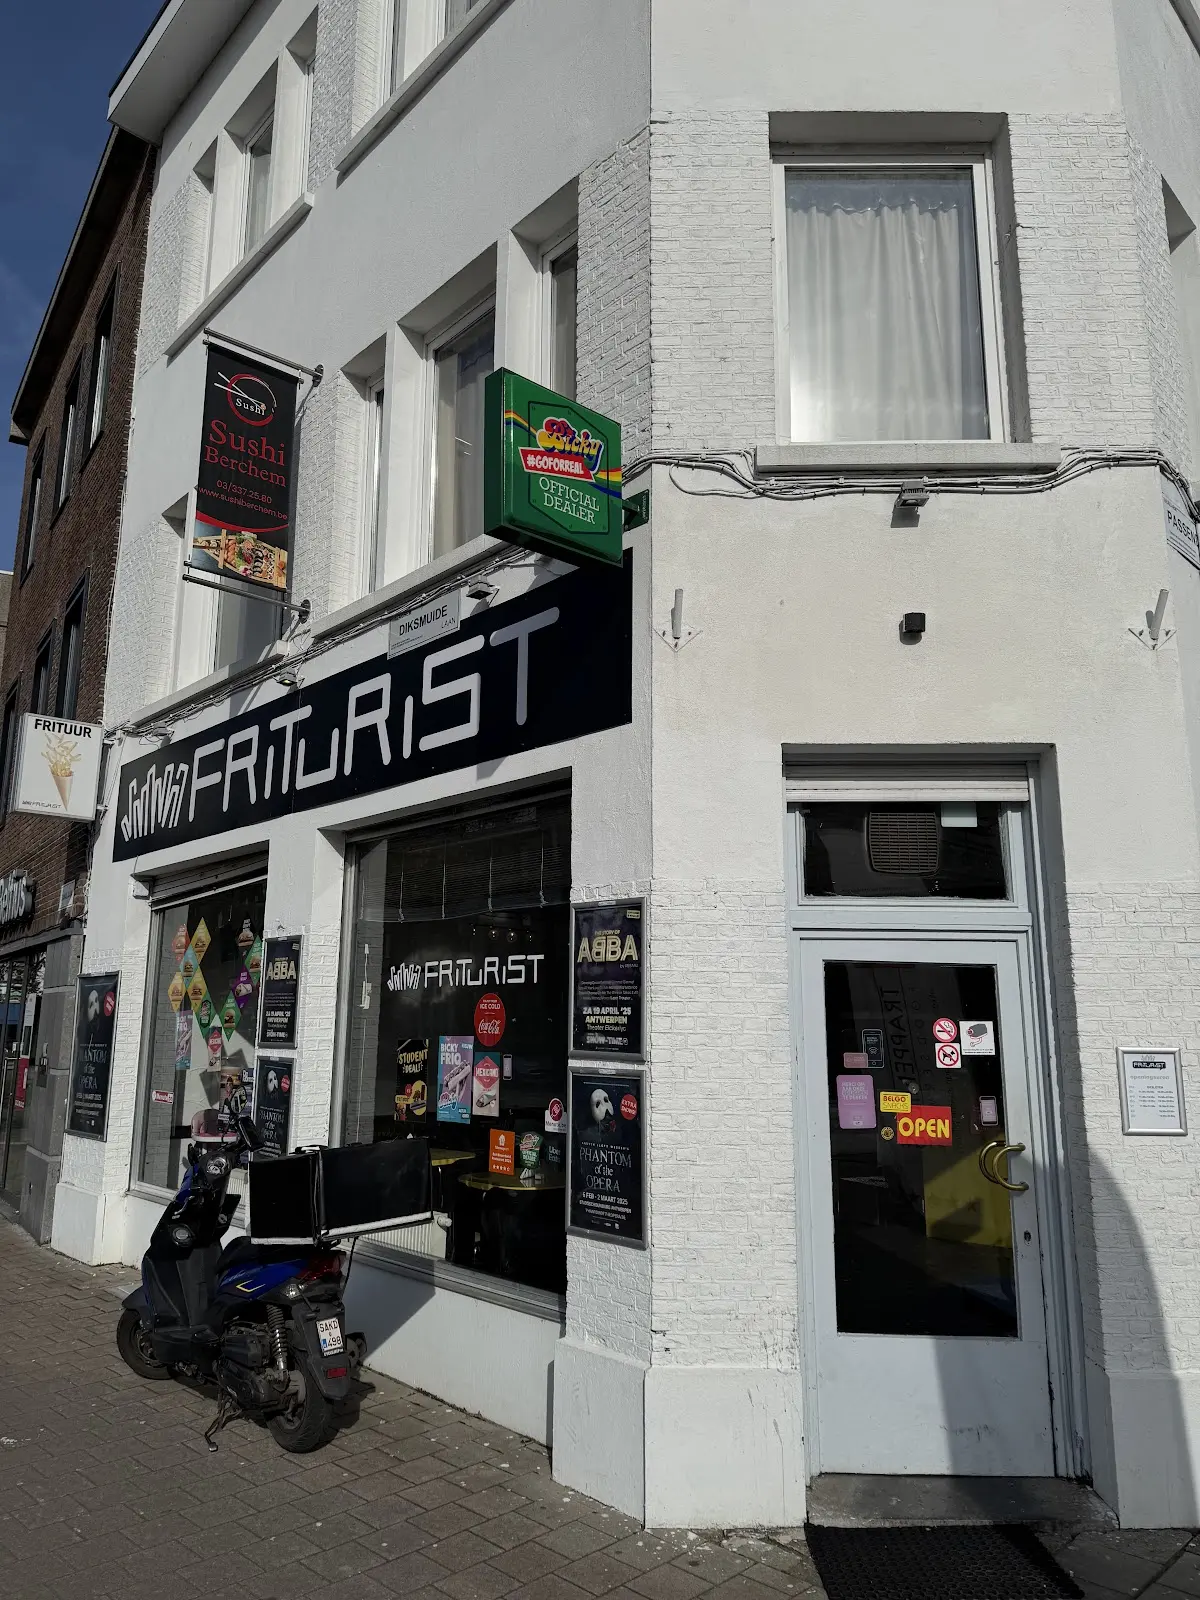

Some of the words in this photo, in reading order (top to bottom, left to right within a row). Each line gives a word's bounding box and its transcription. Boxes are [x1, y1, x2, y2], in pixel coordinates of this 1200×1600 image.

[235, 397, 266, 416] Sushi
[208, 418, 286, 467] Sushi
[536, 417, 604, 473] Bicky
[203, 444, 287, 488] Berchem
[526, 453, 585, 475] #GOFORREAL
[215, 478, 273, 505] 03/337.25.80
[538, 476, 600, 512] OFFICIAL
[198, 486, 288, 520] www.sushiberchem.be
[543, 492, 596, 525] DEALER
[398, 604, 448, 637] DIKSMUIDE
[441, 617, 456, 629] LAAN
[34, 718, 92, 739] FRITUUR
[577, 934, 639, 963] ABBA
[265, 960, 297, 981] ABBA
[582, 1006, 592, 1015] ZA
[593, 1006, 600, 1015] 19
[600, 1006, 619, 1016] APRIL
[584, 1015, 628, 1025] ANTWERPEN
[398, 1048, 429, 1065] STUDENT
[440, 1043, 459, 1053] BICKY
[882, 1102, 909, 1111] SNACKS
[883, 1095, 907, 1103] BELGO
[898, 1116, 950, 1139] OPEN
[548, 1145, 561, 1156] Uber
[579, 1146, 632, 1168] PHANTOM
[594, 1163, 602, 1175] of
[602, 1163, 614, 1177] the
[585, 1174, 621, 1193] OPERA
[600, 1194, 617, 1203] MAART
[616, 1197, 629, 1206] 2025
[319, 1319, 339, 1333] SAKD
[327, 1335, 342, 1348] 498
